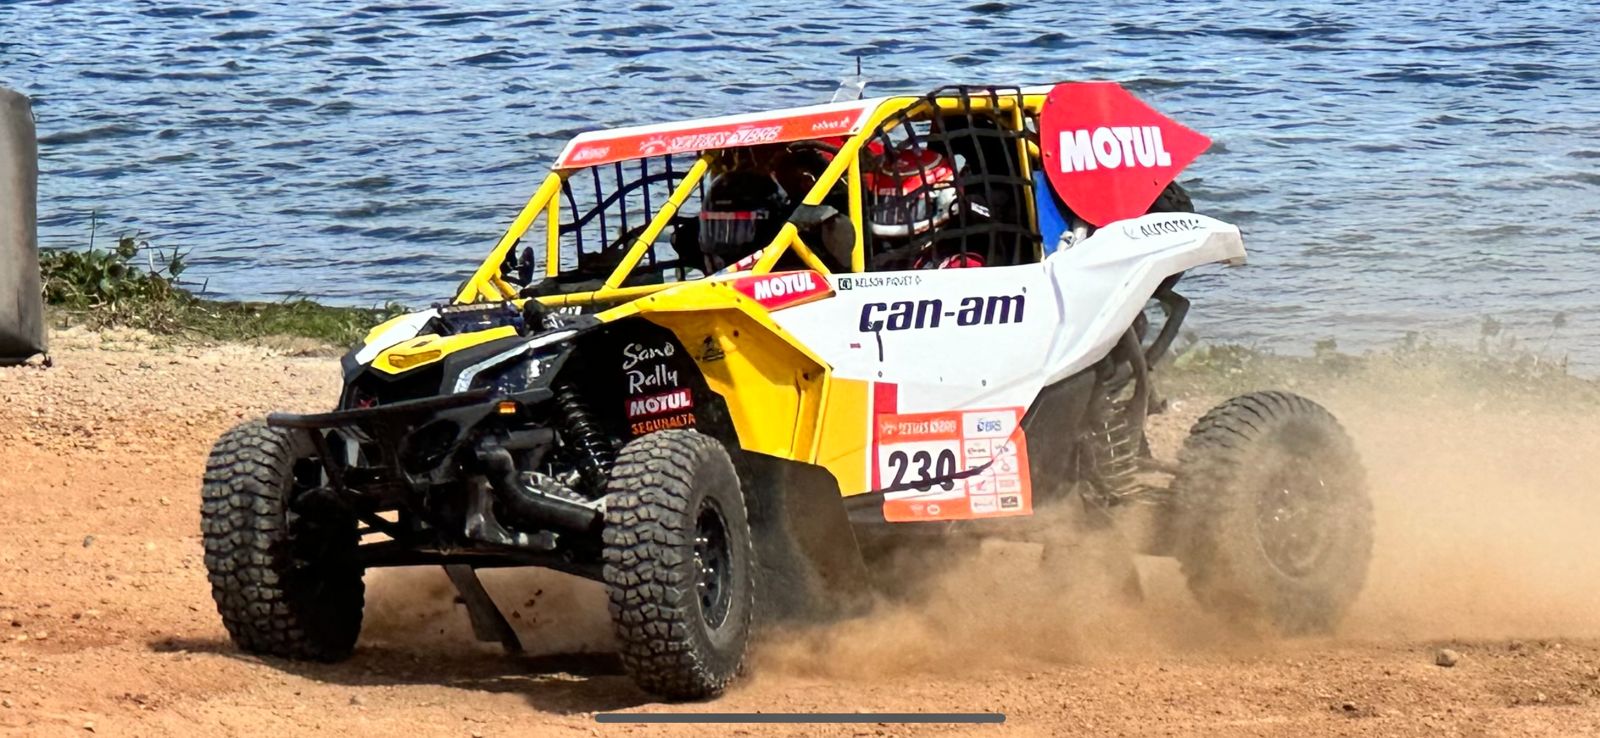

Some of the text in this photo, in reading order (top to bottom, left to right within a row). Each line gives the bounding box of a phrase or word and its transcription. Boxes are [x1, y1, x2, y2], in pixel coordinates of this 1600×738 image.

[1059, 126, 1172, 173] MOTUL
[754, 272, 816, 300] MOTUL
[859, 294, 1026, 333] can-am
[626, 363, 679, 394] Rally
[629, 391, 691, 417] MOTUL
[887, 448, 957, 493] 230
